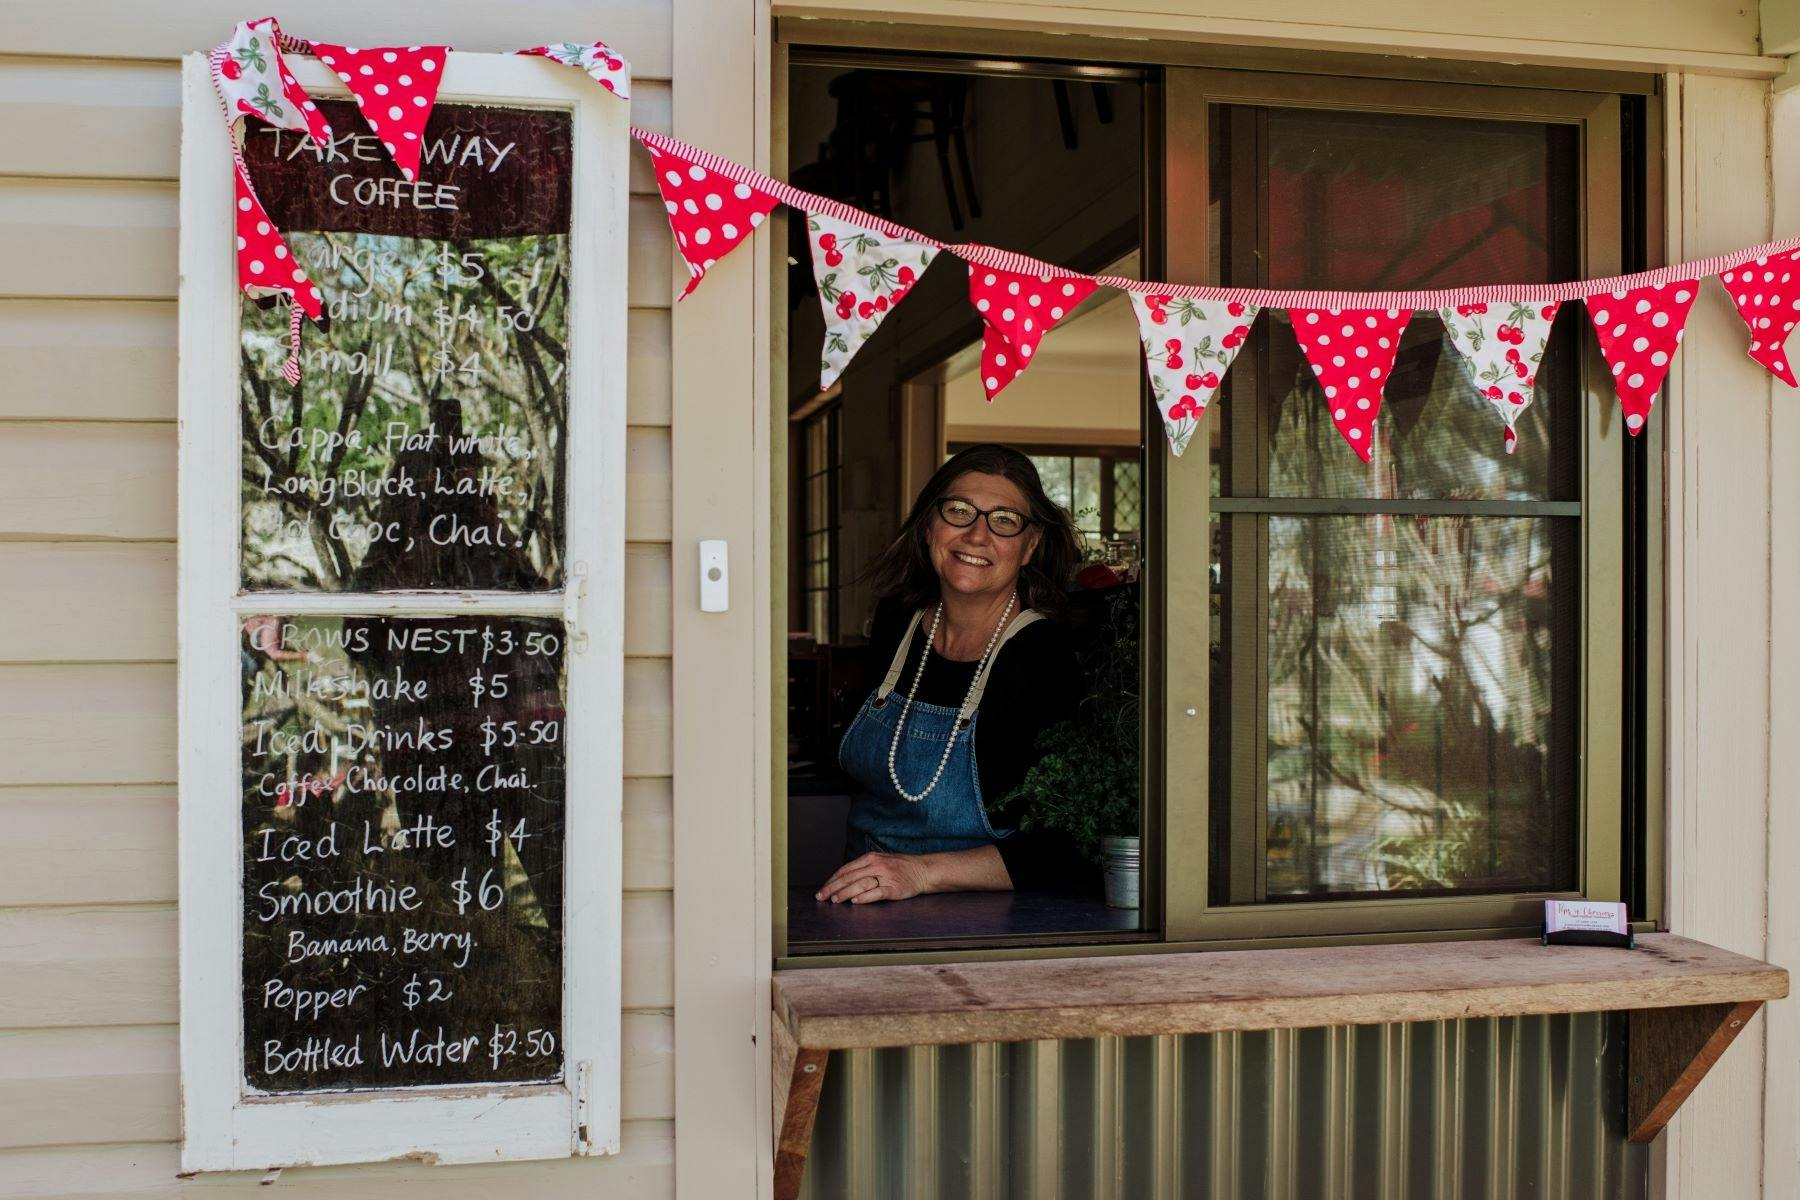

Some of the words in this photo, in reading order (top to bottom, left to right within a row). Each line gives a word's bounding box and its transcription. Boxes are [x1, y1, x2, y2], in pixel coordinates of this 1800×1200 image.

[259, 127, 381, 163] TAKE
[393, 134, 516, 173] WAY
[330, 173, 461, 210] COFFEE
[311, 243, 397, 298] arge
[436, 242, 485, 292] $5
[275, 289, 413, 326] Mdium
[432, 341, 487, 388] $4
[385, 421, 441, 457] Flat
[264, 468, 336, 507] Long
[343, 466, 426, 500] Black,
[434, 465, 528, 505] Latte,
[249, 623, 370, 652] CROWS
[388, 628, 478, 655] NEST
[468, 667, 509, 708] $5
[252, 719, 328, 757] Iced
[346, 716, 454, 756] Drinks
[346, 765, 470, 794] Chocolate,
[257, 821, 340, 862] Iced
[364, 813, 456, 853] Latte
[485, 808, 532, 858] $4
[258, 876, 423, 922] Smoothie
[451, 867, 503, 915] $6
[288, 930, 397, 964] Banana,
[264, 978, 367, 1021] Popper
[402, 972, 453, 1011] $2
[264, 1034, 364, 1075] Bottled
[381, 1026, 479, 1068] Water
